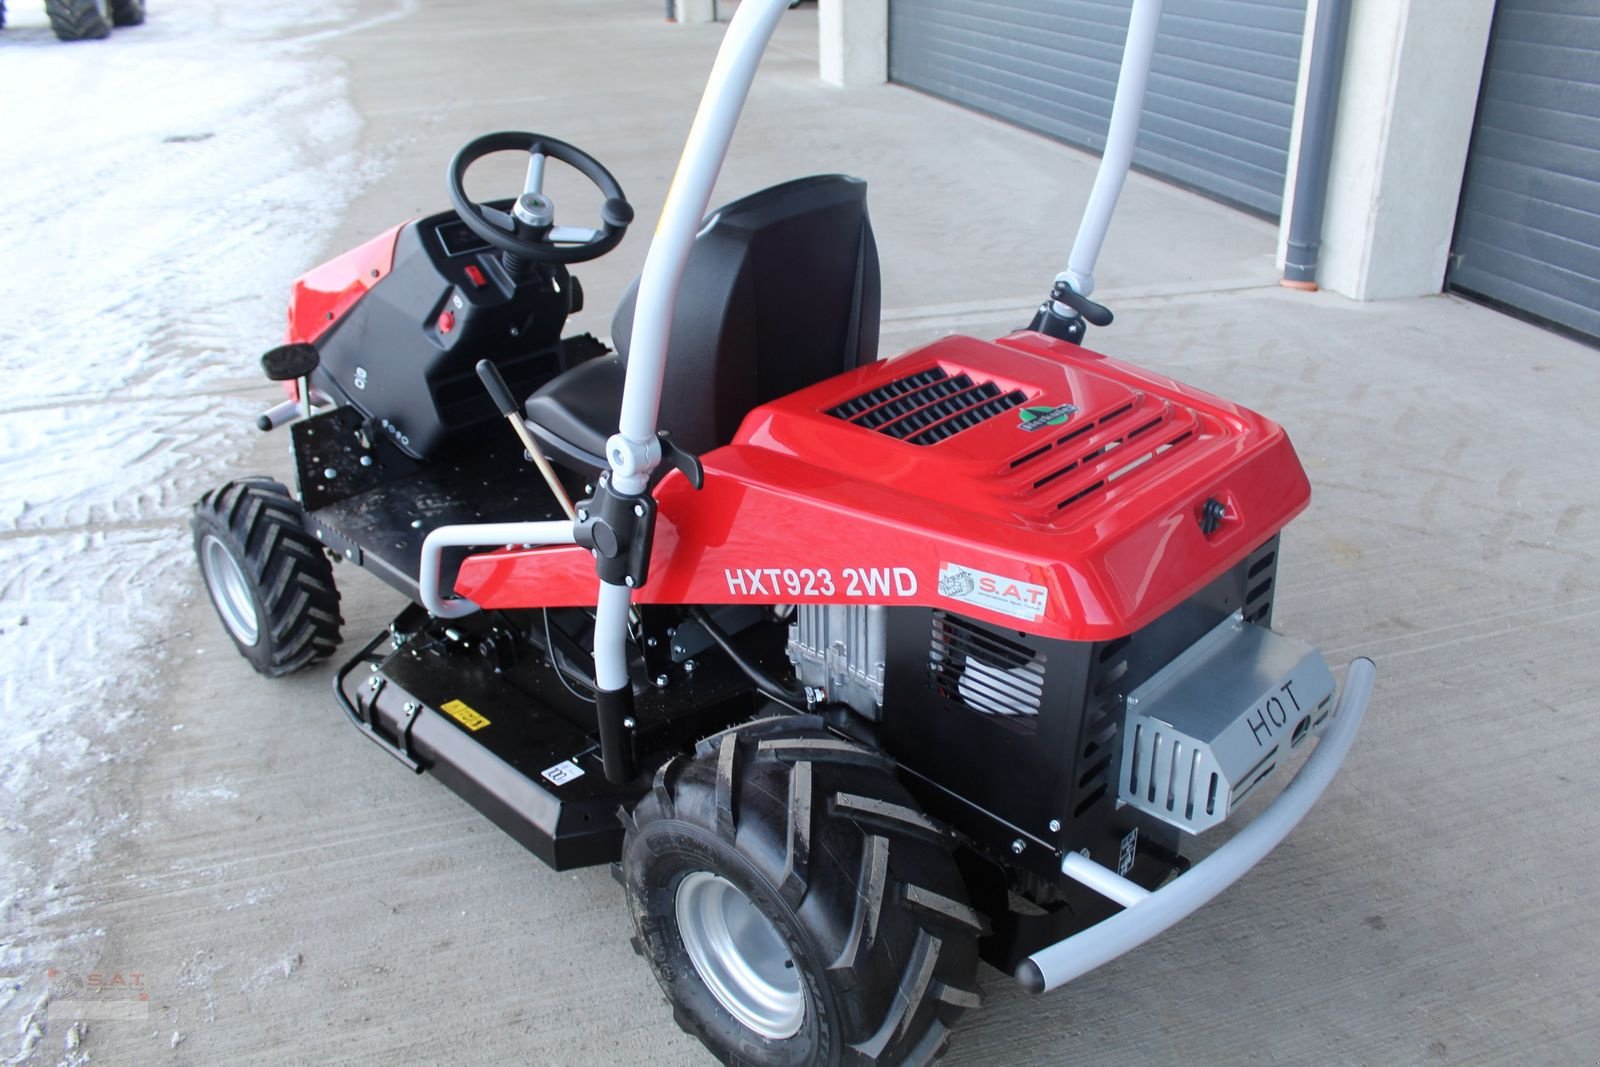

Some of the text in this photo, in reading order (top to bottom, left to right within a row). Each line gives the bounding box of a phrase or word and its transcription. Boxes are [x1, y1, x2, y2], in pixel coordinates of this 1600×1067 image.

[724, 567, 918, 597] HXT923 2WD
[979, 577, 1044, 606] S.A.T.
[1246, 679, 1301, 747] HOT
